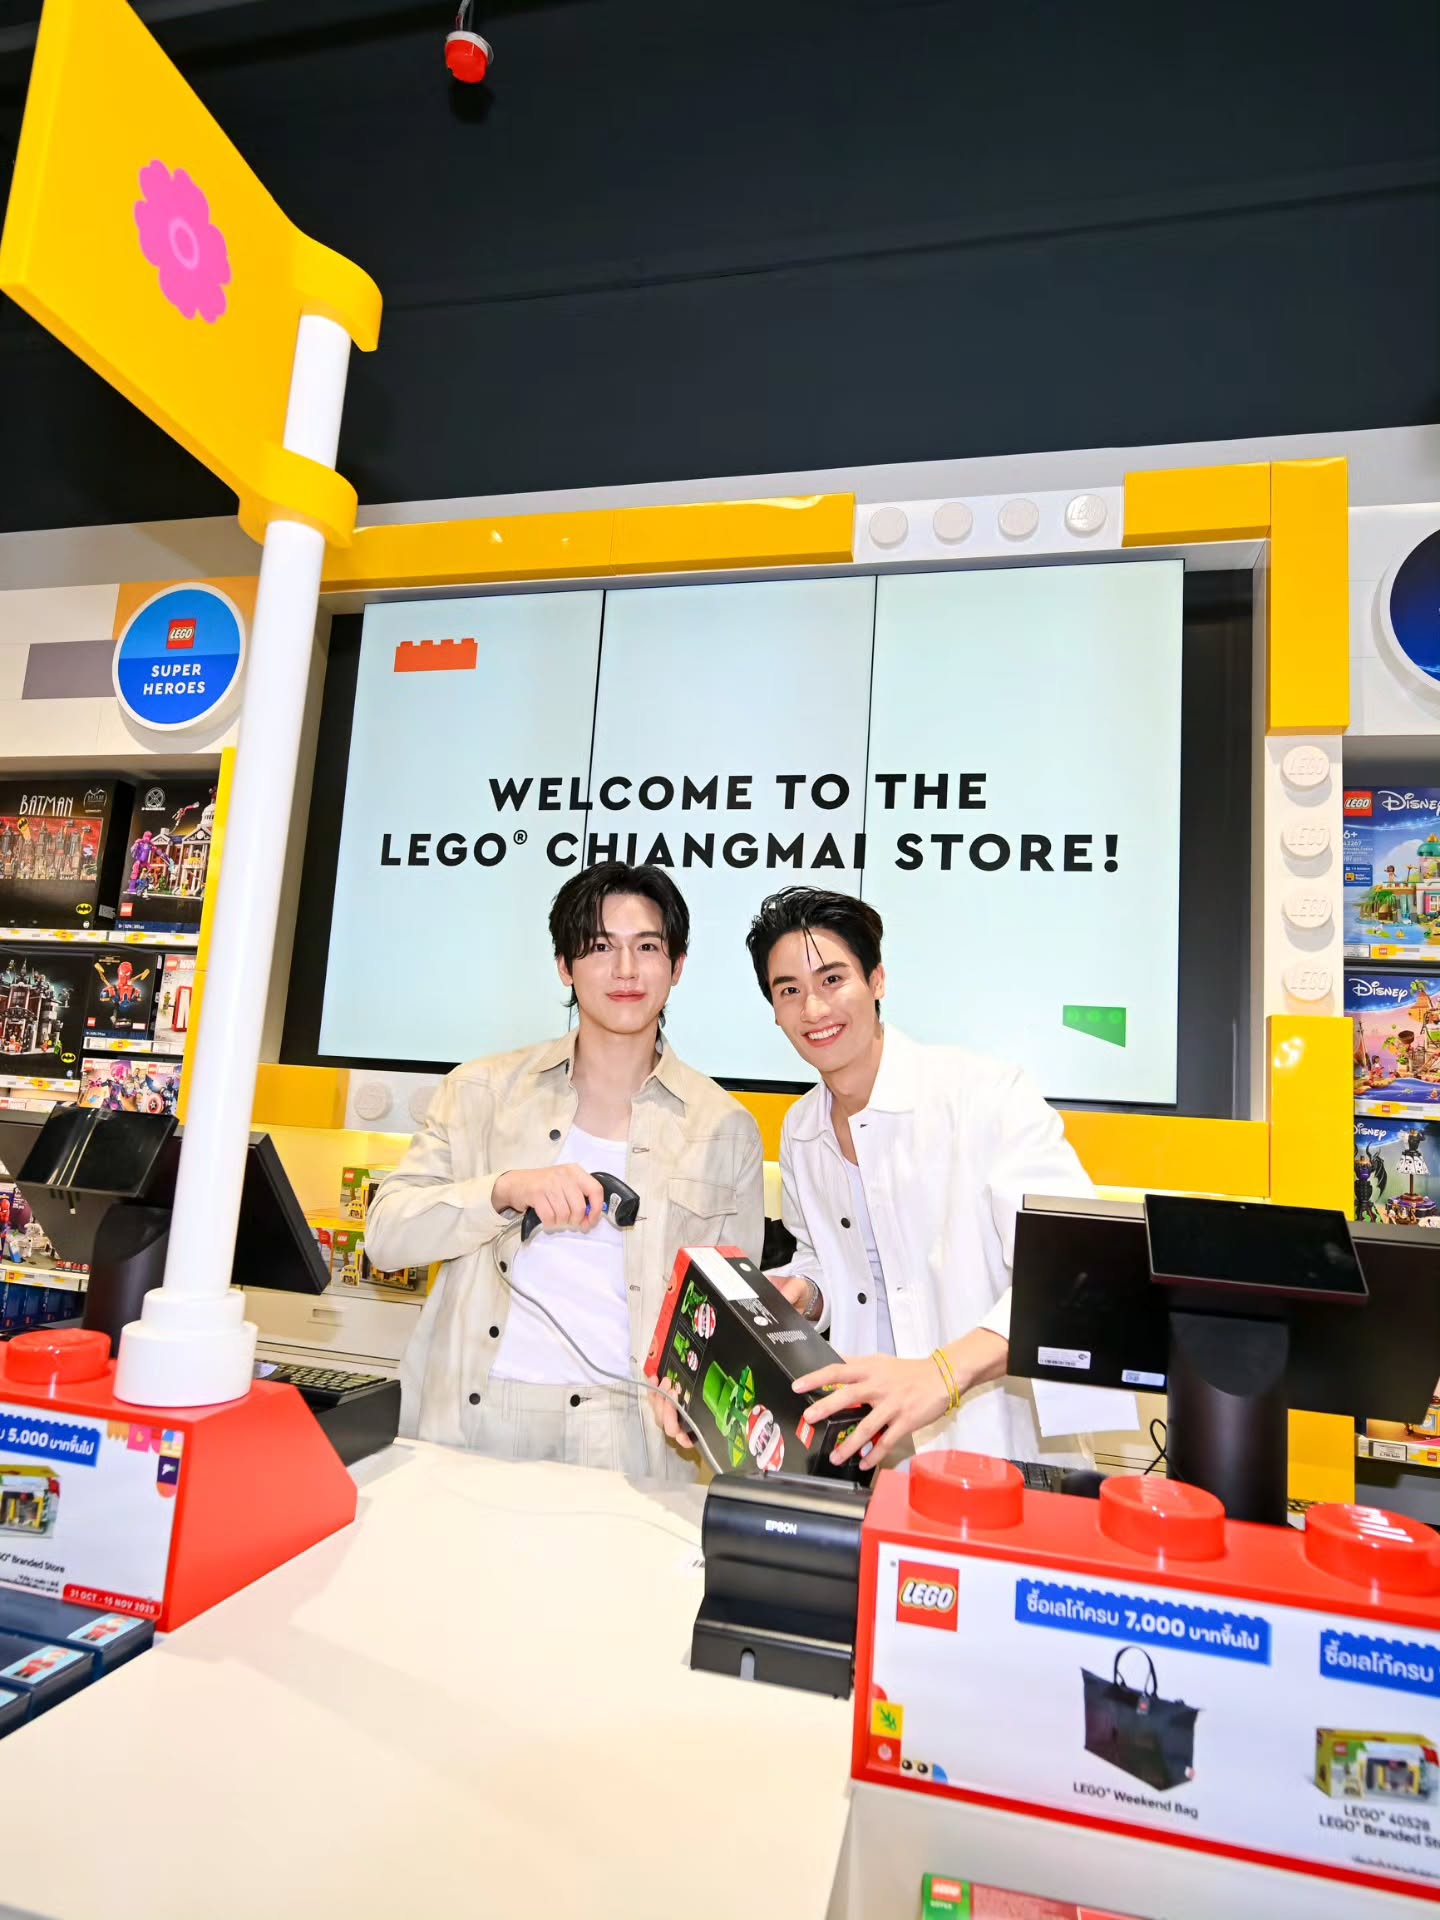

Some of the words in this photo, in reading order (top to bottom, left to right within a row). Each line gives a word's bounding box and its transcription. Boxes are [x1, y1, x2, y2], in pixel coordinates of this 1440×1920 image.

[168, 627, 195, 640] LEGO
[151, 663, 202, 678] SUPER
[143, 681, 206, 696] HEROES
[488, 774, 753, 812] WELCOME
[775, 773, 850, 810] TO
[875, 772, 987, 810] THE
[19, 794, 74, 817] BATMAN
[1344, 798, 1371, 810] LEGO
[546, 832, 867, 870] CHIANGMAI
[894, 832, 1119, 873] STORE!
[8, 1427, 49, 1448] 5,000
[765, 1519, 797, 1535] EPSON
[80, 1590, 97, 1601] OCT
[114, 1599, 133, 1609] NOV
[901, 1578, 956, 1611] LEGO
[1124, 1609, 1185, 1638] 7,000
[1113, 1790, 1172, 1812] Weekend
[1174, 1803, 1199, 1820] Bag
[1363, 1823, 1422, 1846] Branded
